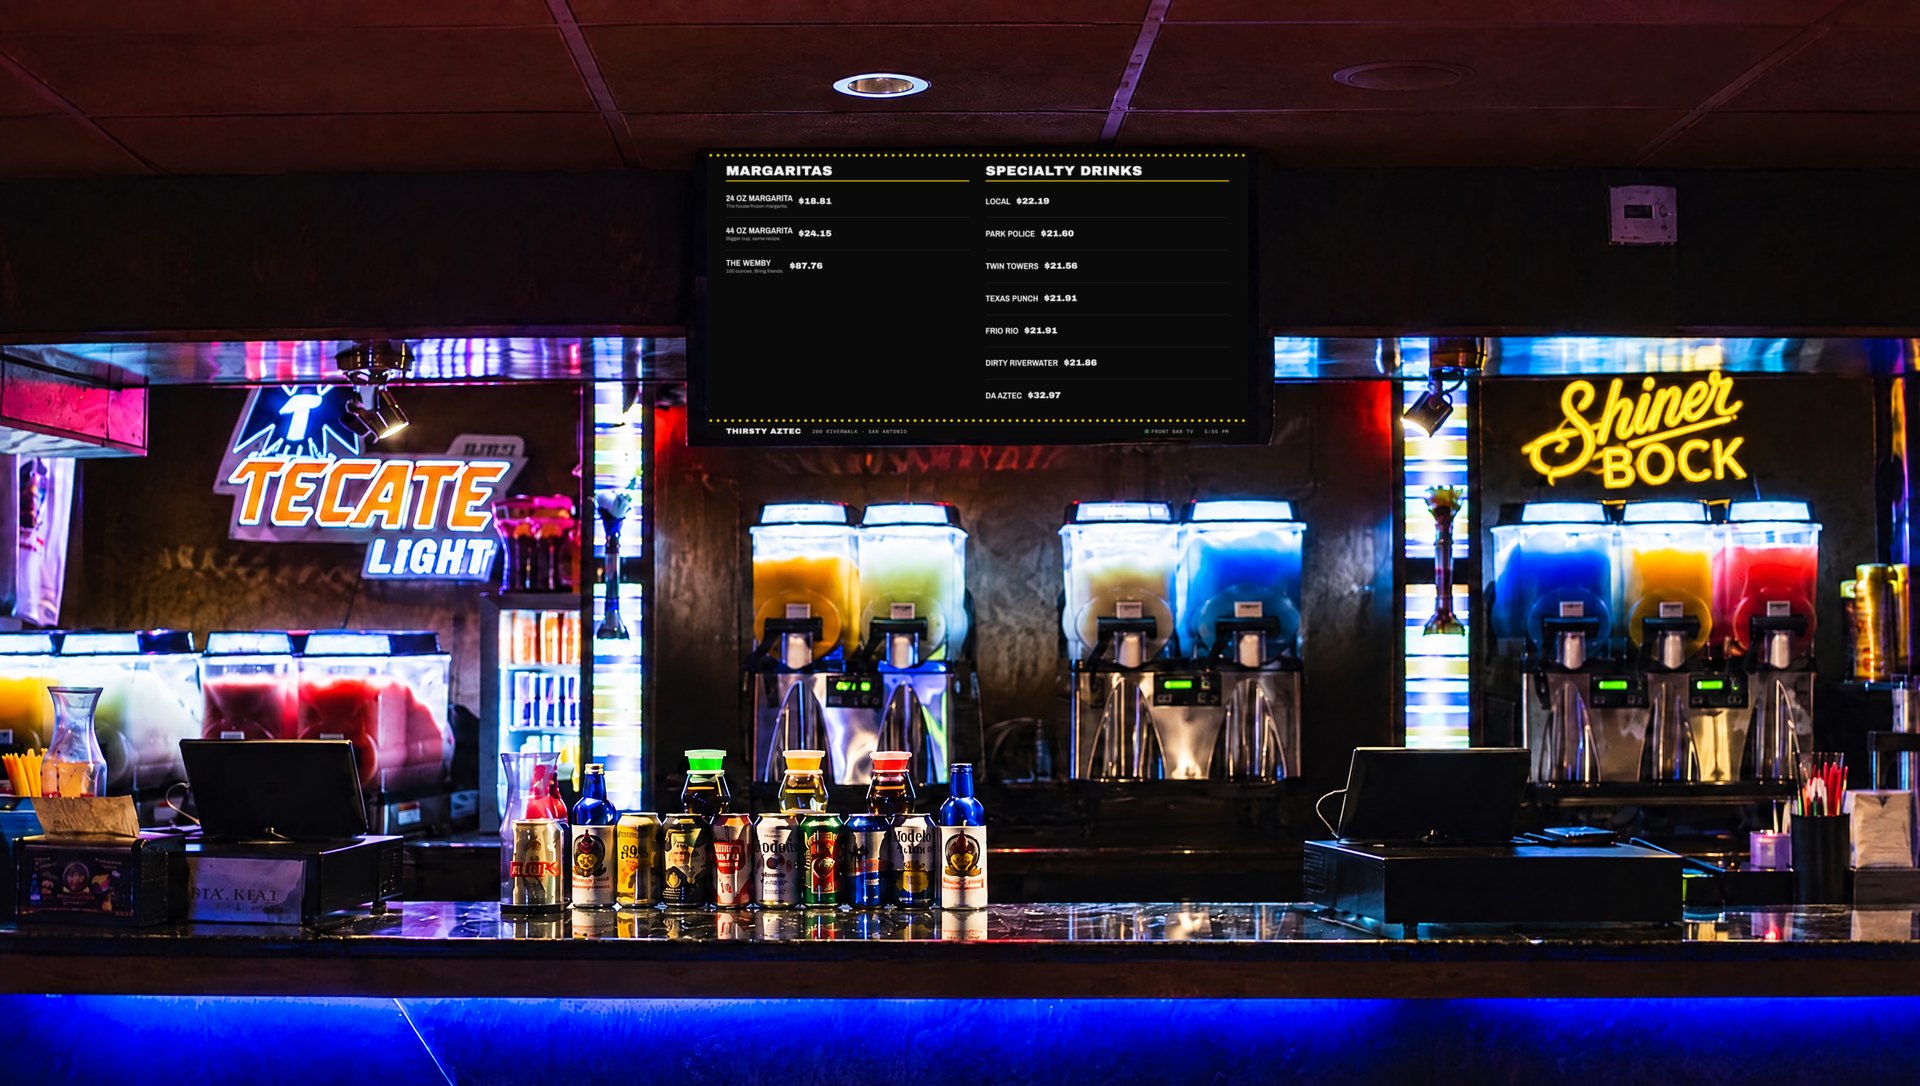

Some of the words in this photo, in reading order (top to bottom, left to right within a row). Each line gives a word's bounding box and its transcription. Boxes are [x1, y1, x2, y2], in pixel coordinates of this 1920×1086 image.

[726, 165, 833, 177] MARGARITAS
[985, 165, 1075, 177] SPECIALTY
[1080, 165, 1143, 177] DRINKS
[736, 194, 747, 202] OZ
[749, 194, 793, 202] MARGARITA
[798, 197, 832, 205] $18.81
[985, 197, 1011, 205] LOCAL
[1016, 197, 1050, 205] $22.19
[749, 227, 793, 235] MARGARITA
[798, 229, 832, 238] $24.15
[985, 230, 1006, 238] PARK
[1007, 230, 1036, 238] POLICE
[1040, 229, 1074, 238] $21.60
[726, 259, 741, 267] THE
[743, 259, 772, 267] WEMBY
[789, 262, 823, 270] $87.76
[985, 262, 1005, 270] TWIN
[1006, 262, 1040, 270] TOWERS
[1044, 262, 1078, 270] $21.56
[985, 294, 1011, 303] TEXAS
[1012, 294, 1039, 303] PUNCH
[1044, 294, 1077, 303] $21.91
[985, 327, 1004, 335] FRIO
[1005, 327, 1019, 335] RIO
[1024, 327, 1058, 335] $21.91
[985, 359, 1008, 367] DIRTY
[1009, 359, 1059, 367] RIVERWATER
[1063, 359, 1098, 367] $21.86
[985, 392, 997, 400] DA
[997, 392, 1022, 400] AZTEC
[1027, 391, 1061, 400] $32.97
[1520, 370, 1744, 482] Shiner
[726, 427, 768, 435] THIRSTY
[770, 427, 802, 435] AZTEC
[1601, 436, 1748, 490] BOCK
[227, 457, 511, 532] TECATE
[366, 538, 498, 576] LIGHT
